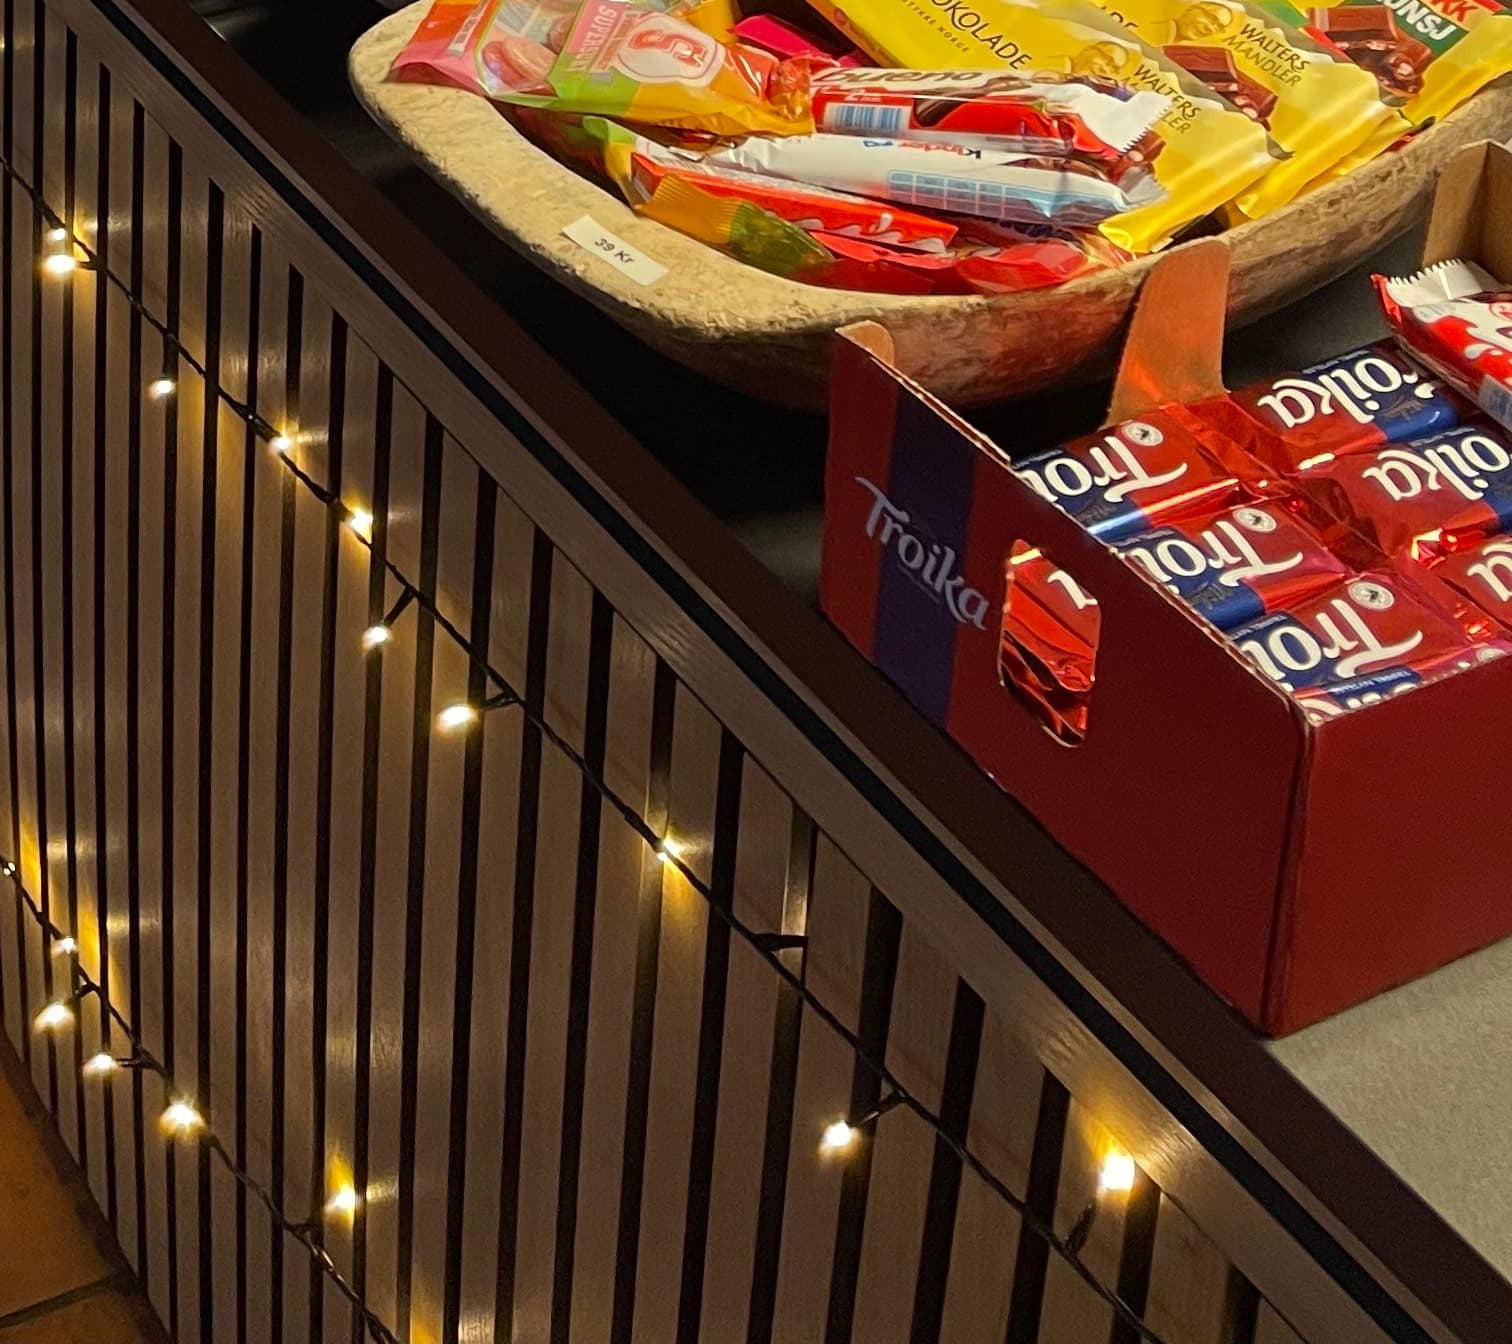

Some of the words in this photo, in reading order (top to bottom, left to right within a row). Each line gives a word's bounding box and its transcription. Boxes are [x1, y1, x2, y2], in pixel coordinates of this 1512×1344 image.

[1223, 34, 1303, 88] MANDLER
[1240, 23, 1311, 73] WALTERS
[813, 69, 986, 84] bueno
[899, 141, 981, 160] Kinder
[594, 238, 615, 252] 39
[614, 250, 635, 264] Kr
[854, 476, 990, 631] Troika
